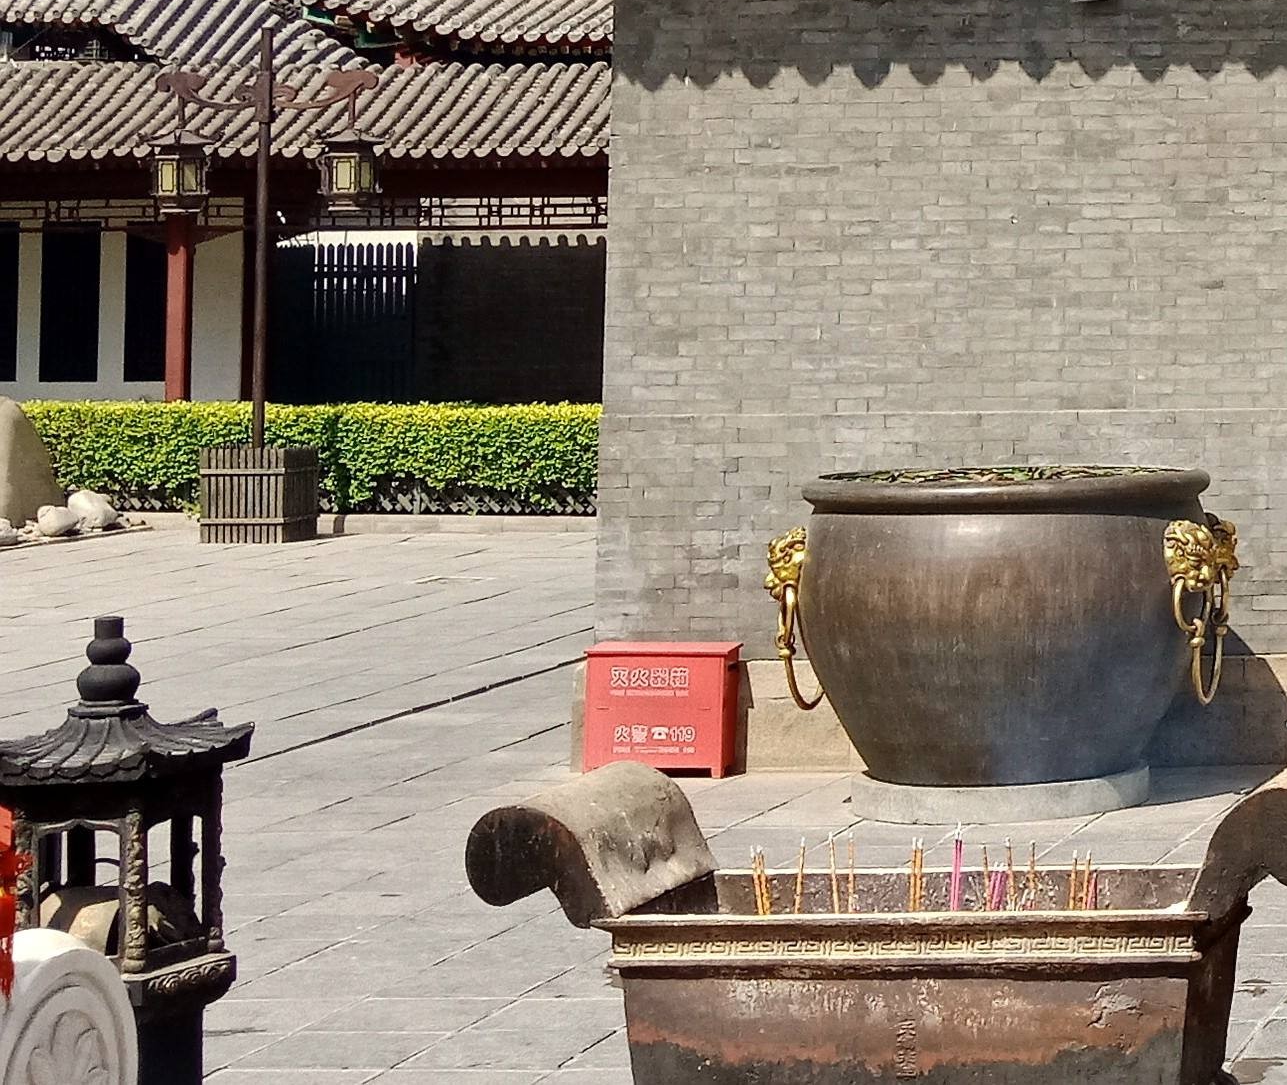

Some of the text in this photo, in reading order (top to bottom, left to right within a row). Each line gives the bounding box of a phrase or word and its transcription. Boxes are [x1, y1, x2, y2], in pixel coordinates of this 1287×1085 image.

[610, 667, 690, 687] 灭火器箱
[670, 726, 696, 742] 119
